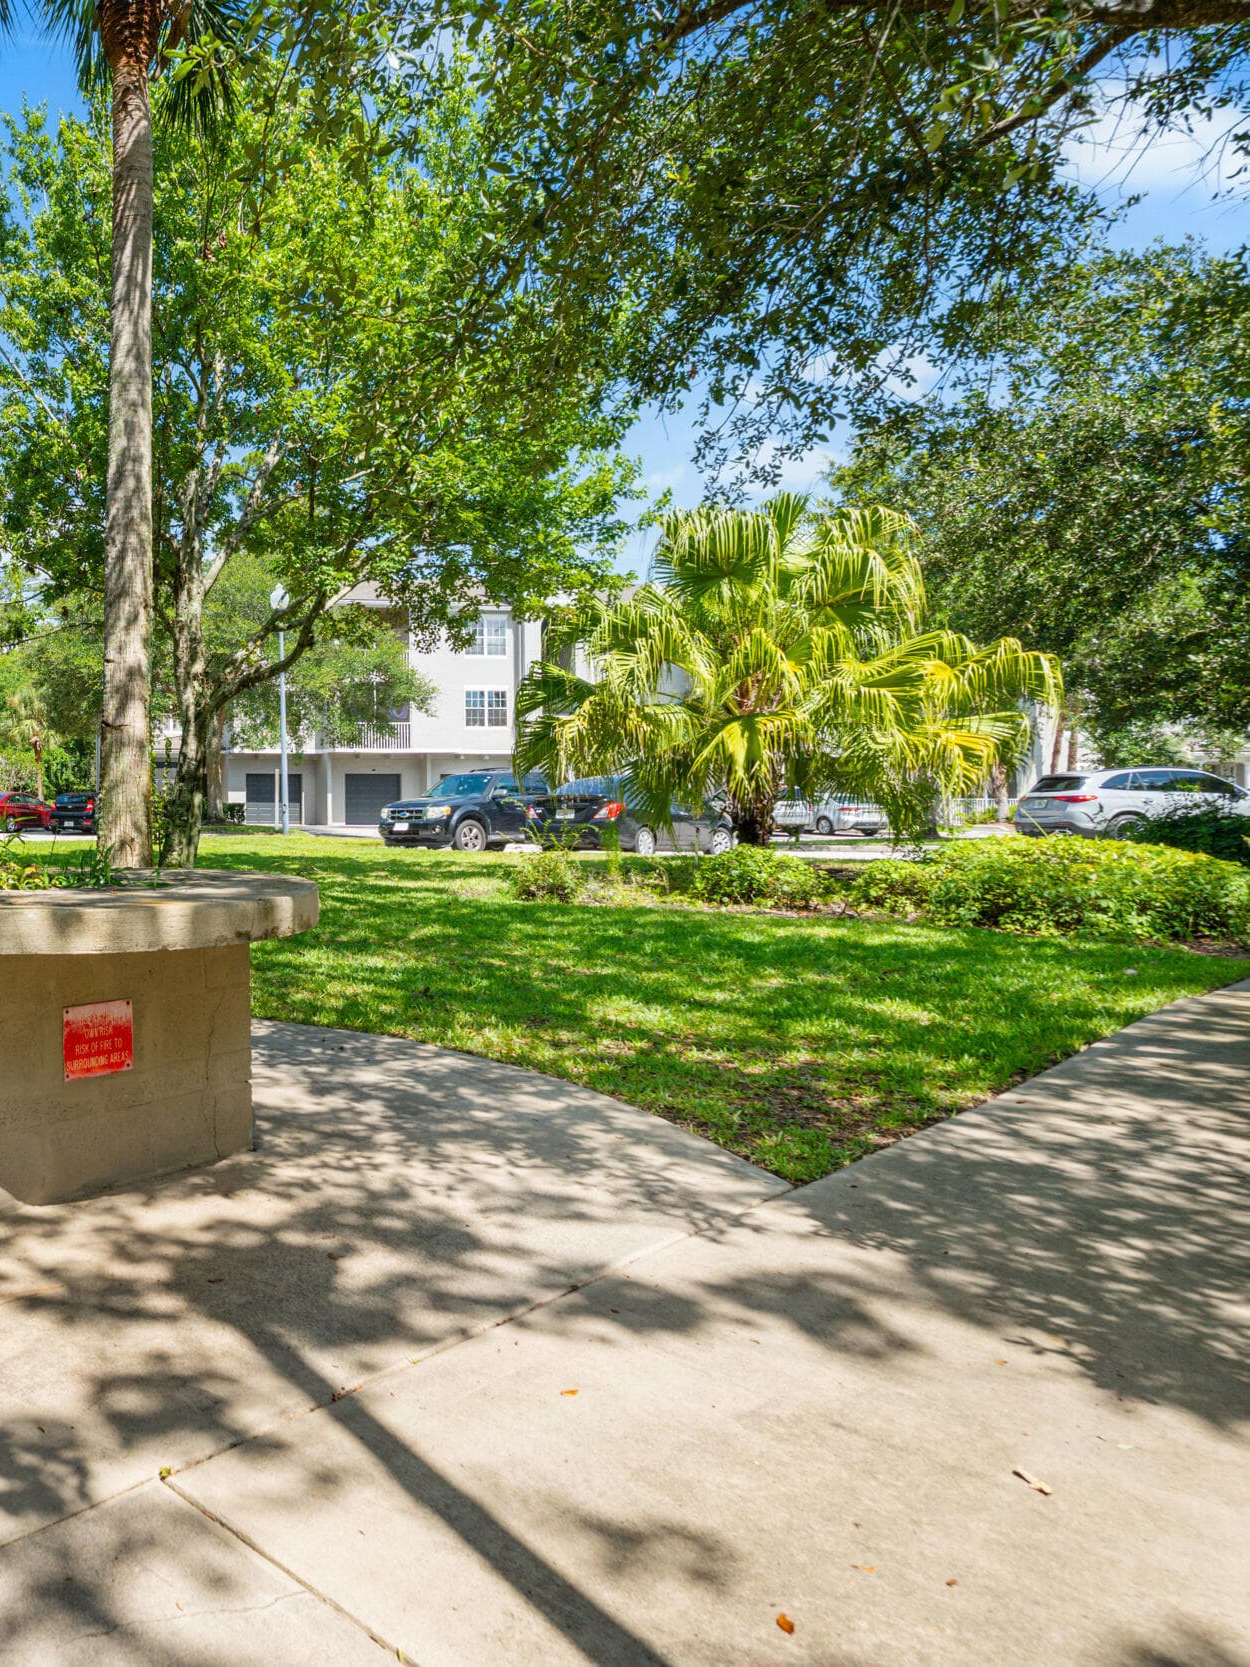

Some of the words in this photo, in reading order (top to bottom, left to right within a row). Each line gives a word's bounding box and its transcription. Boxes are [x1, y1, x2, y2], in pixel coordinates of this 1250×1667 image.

[84, 1026, 98, 1039] OWN
[99, 1024, 113, 1037] RISK
[75, 1043, 89, 1056] RISK
[91, 1041, 100, 1053] OF
[100, 1038, 113, 1051] FIRE
[114, 1037, 124, 1049] TO
[66, 1054, 109, 1072] SURROUNDING
[110, 1050, 130, 1063] AREAS
